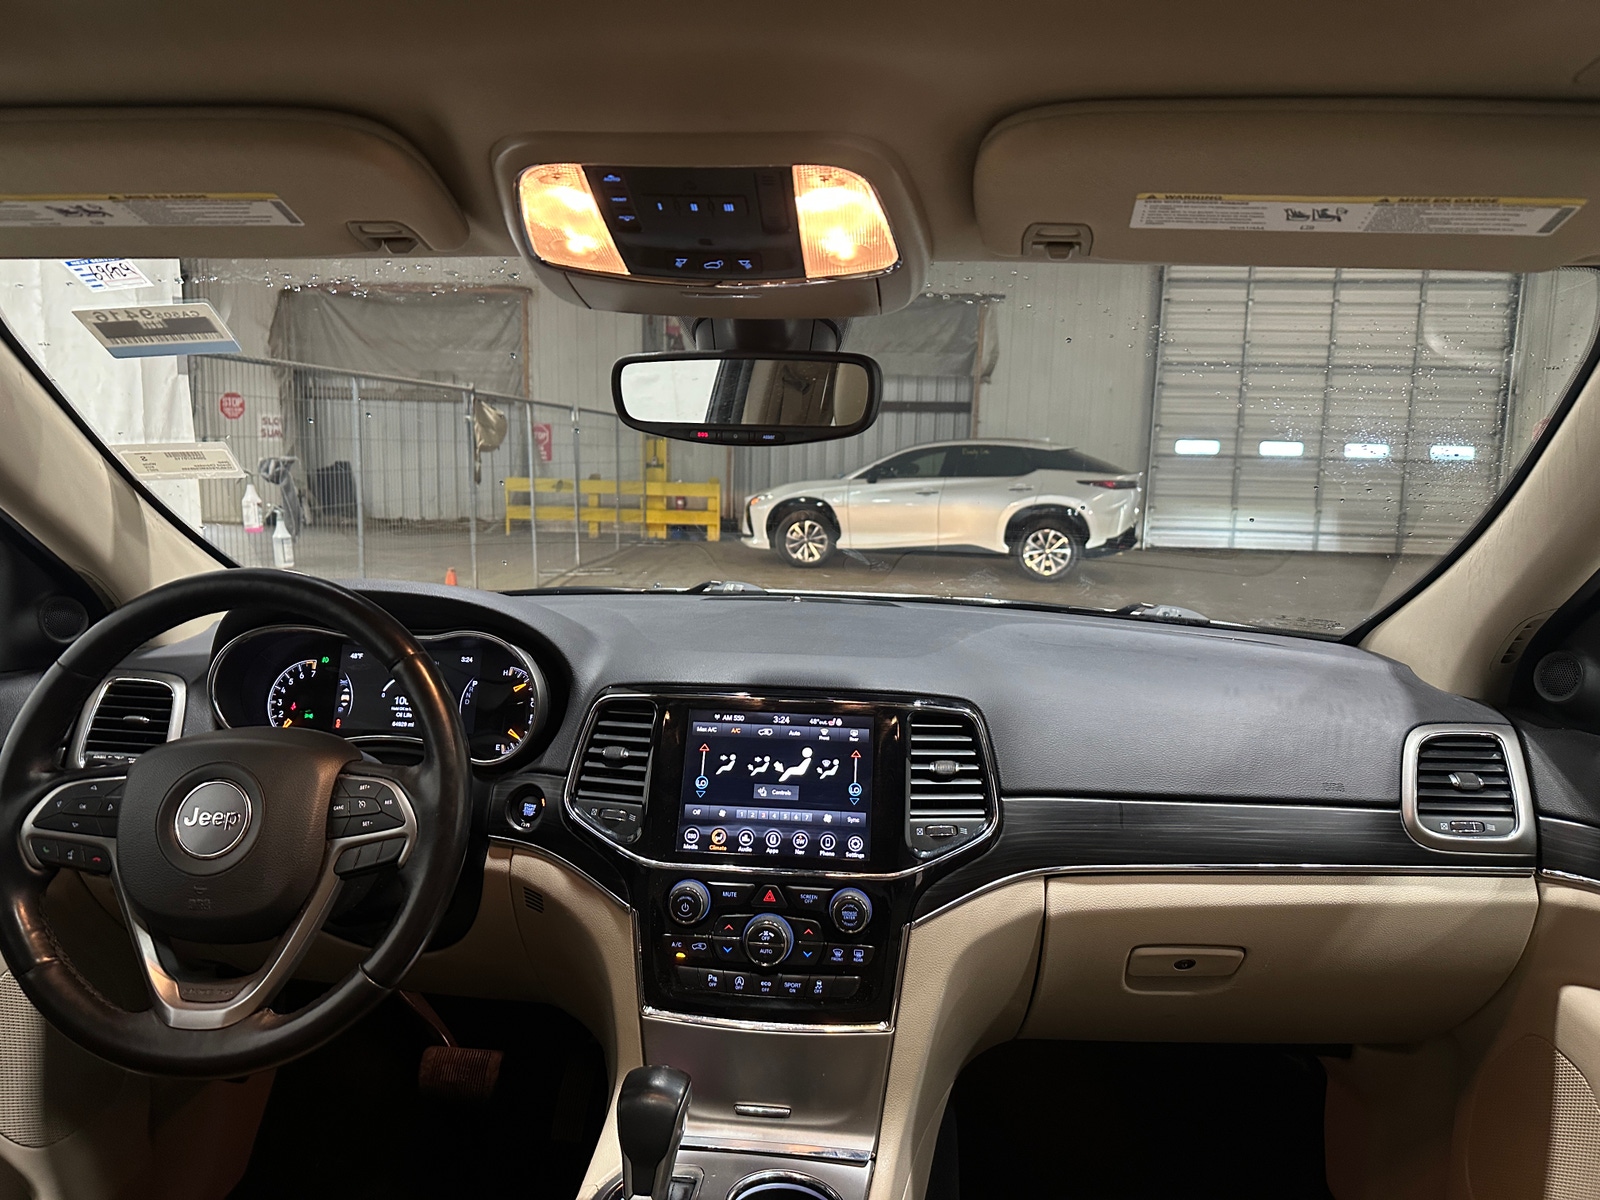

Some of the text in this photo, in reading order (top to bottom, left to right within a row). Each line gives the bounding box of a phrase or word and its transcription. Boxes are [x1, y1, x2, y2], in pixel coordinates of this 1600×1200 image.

[722, 714, 745, 722] AM 550
[772, 715, 790, 724] 3:24
[183, 806, 241, 831] Jeep
